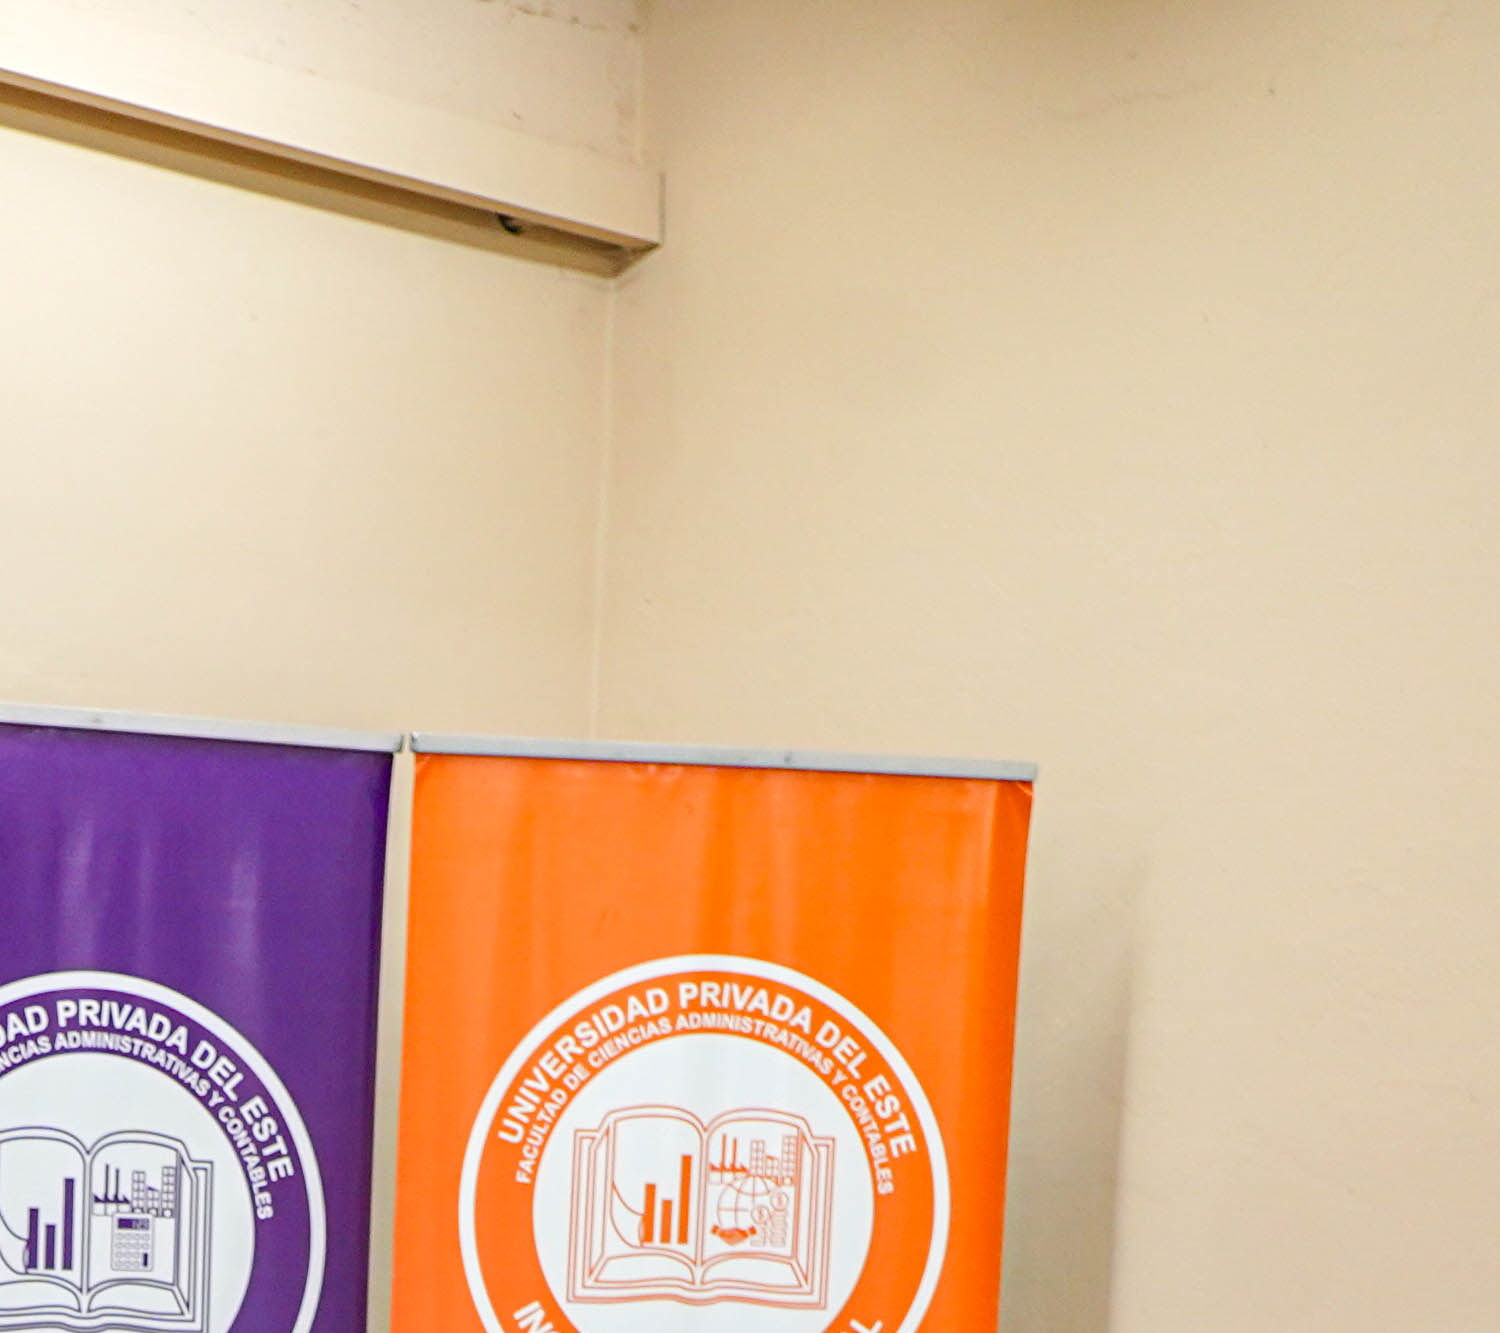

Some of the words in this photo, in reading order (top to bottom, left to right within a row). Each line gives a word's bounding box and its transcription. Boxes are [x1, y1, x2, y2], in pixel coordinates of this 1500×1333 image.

[55, 1031, 210, 1096] ADMINISTRATIVAS
[207, 1090, 226, 1108] Y
[219, 1107, 274, 1220] CONTABLES
[56, 999, 188, 1054] PRIVADA
[190, 1040, 243, 1102] DEL
[240, 1096, 295, 1181] ESTE
[498, 988, 670, 1144] UNIVERSIDAD
[679, 982, 812, 1034] PRIVADA
[815, 1021, 867, 1080] DEL
[864, 1074, 917, 1157] ESTE
[515, 1088, 568, 1184] FACULTAD
[563, 1062, 591, 1091] DE
[588, 1017, 672, 1068] CIENCIAS
[675, 1012, 834, 1076] ADMINISTRATIVAS
[829, 1069, 847, 1087] Y
[841, 1084, 894, 1196] CONTABLES
